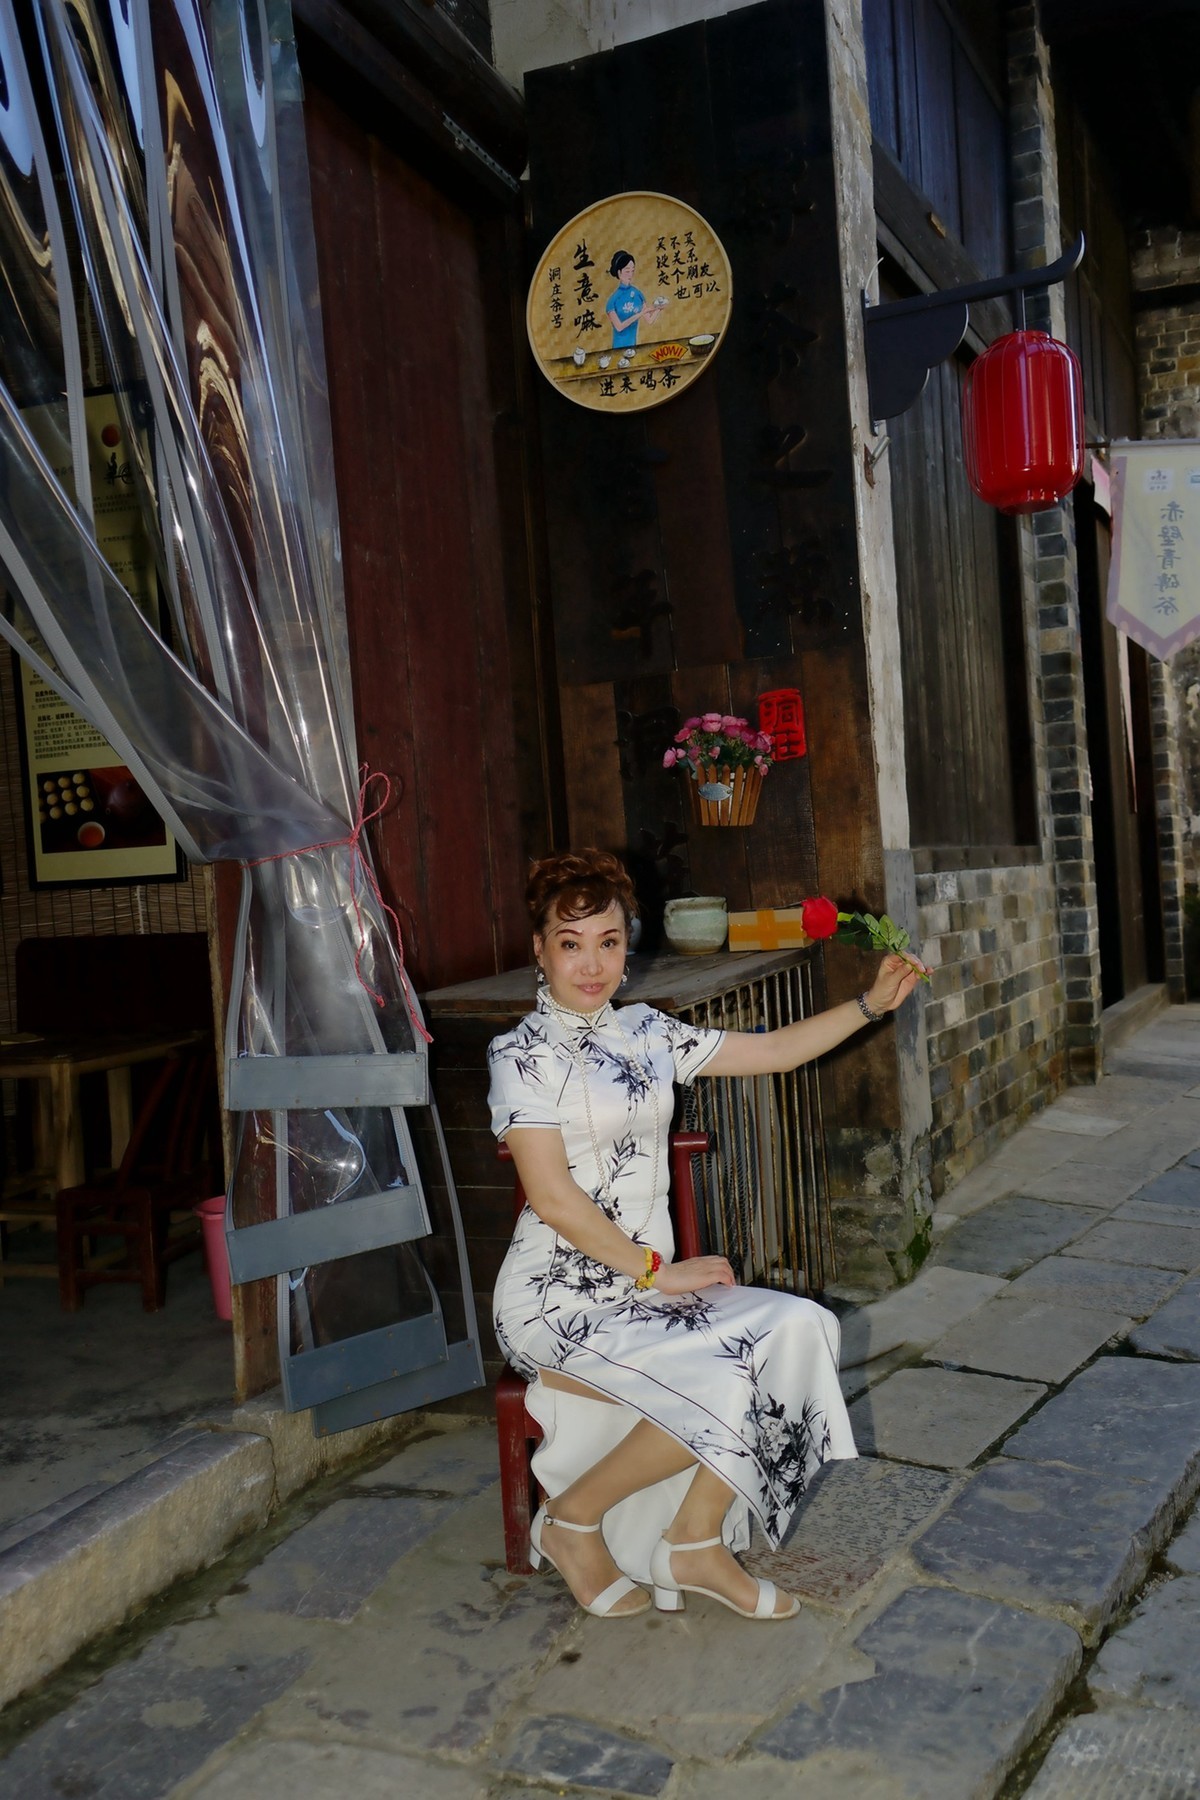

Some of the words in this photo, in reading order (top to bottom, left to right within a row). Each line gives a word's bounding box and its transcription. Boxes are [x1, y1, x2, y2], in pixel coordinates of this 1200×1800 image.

[656, 231, 696, 251] 买不买
[656, 250, 698, 269] 没关系
[658, 262, 714, 287] 交个朋友
[549, 267, 564, 329] 洞庄茶号
[573, 238, 602, 338] 生意嘛
[673, 279, 721, 300] 也可以
[652, 346, 683, 360] WOW!
[599, 366, 681, 397] 进来喝茶
